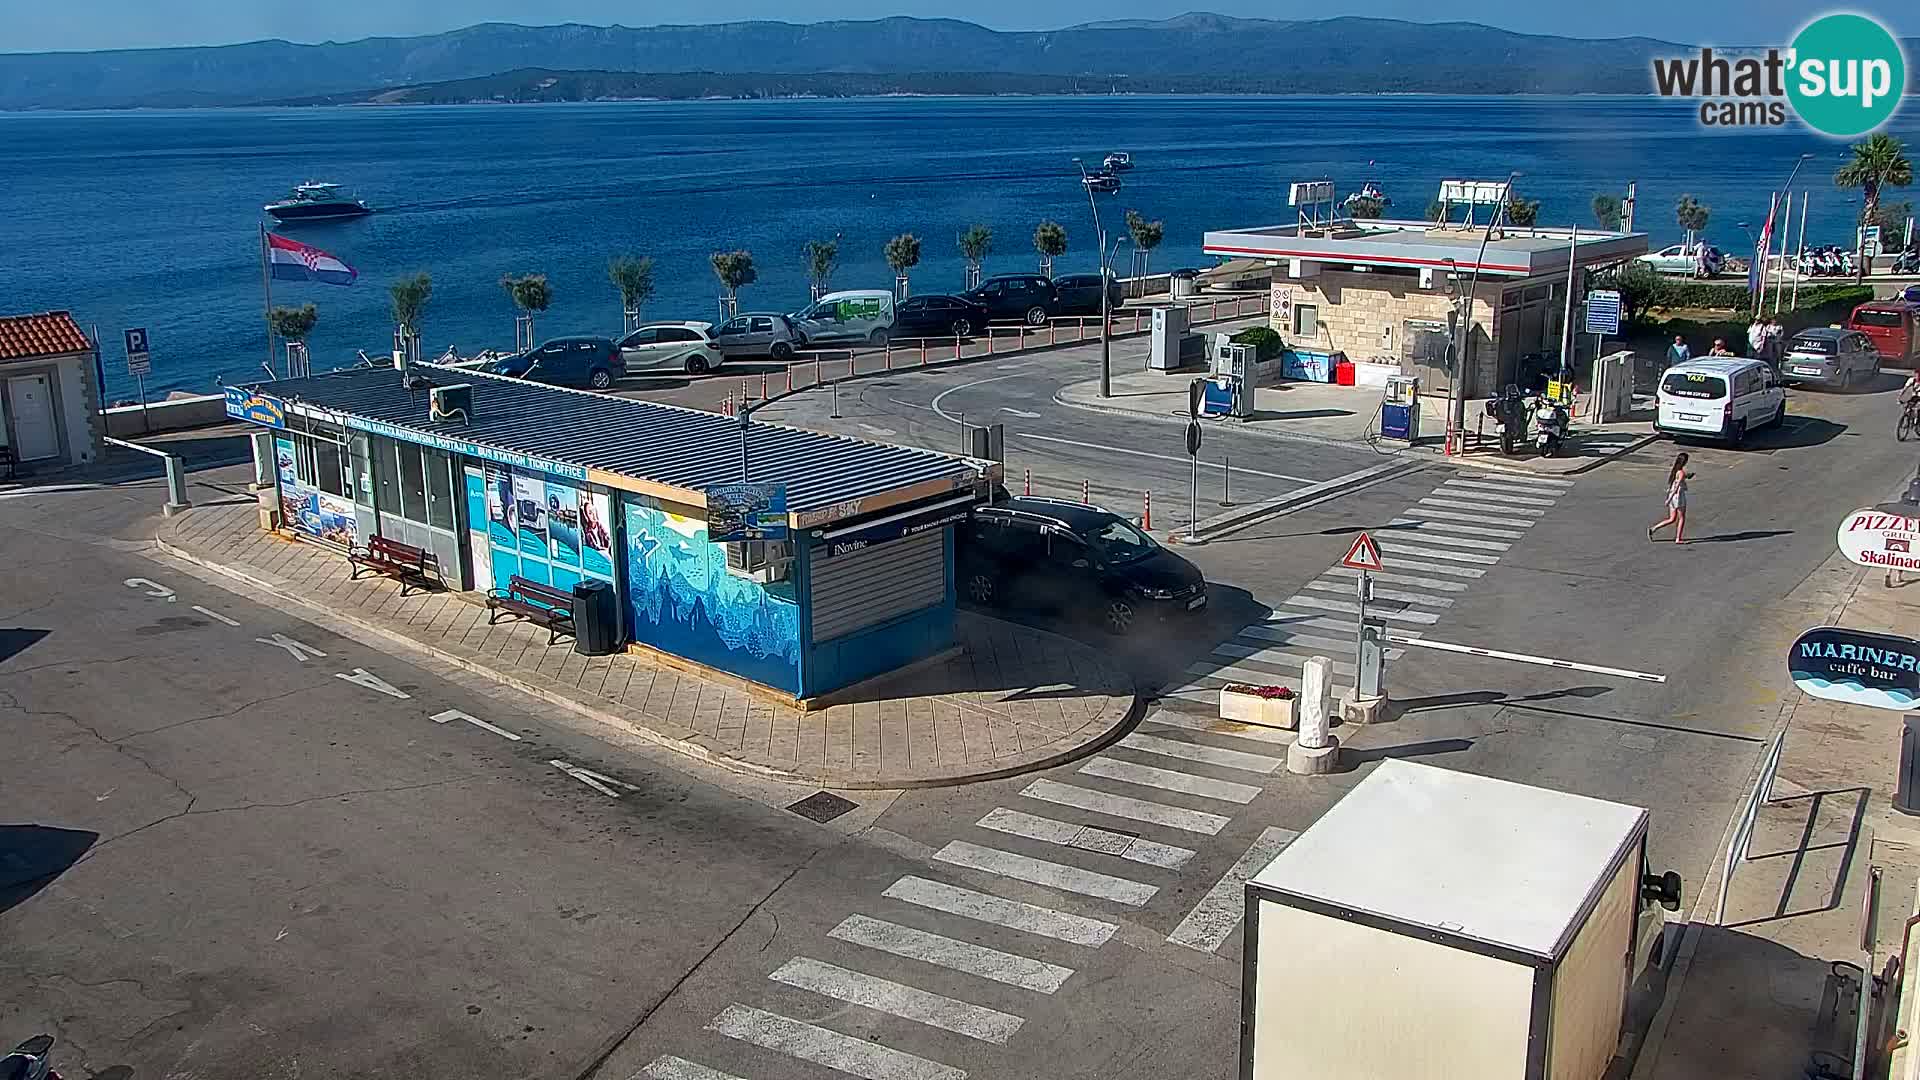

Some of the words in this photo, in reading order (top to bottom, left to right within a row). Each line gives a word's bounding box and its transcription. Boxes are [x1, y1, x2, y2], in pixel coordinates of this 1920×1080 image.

[129, 331, 142, 350] P
[1687, 374, 1706, 382] TAXI
[437, 437, 467, 453] POSTAJA
[477, 446, 493, 459] BUS
[493, 449, 526, 466] STATION
[528, 457, 555, 473] TICKET
[555, 463, 583, 478] OFFICE
[1848, 515, 1920, 533] PIZZE
[1882, 531, 1917, 540] GRILL
[1829, 663, 1866, 676] caffe
[1870, 666, 1897, 681] bar
